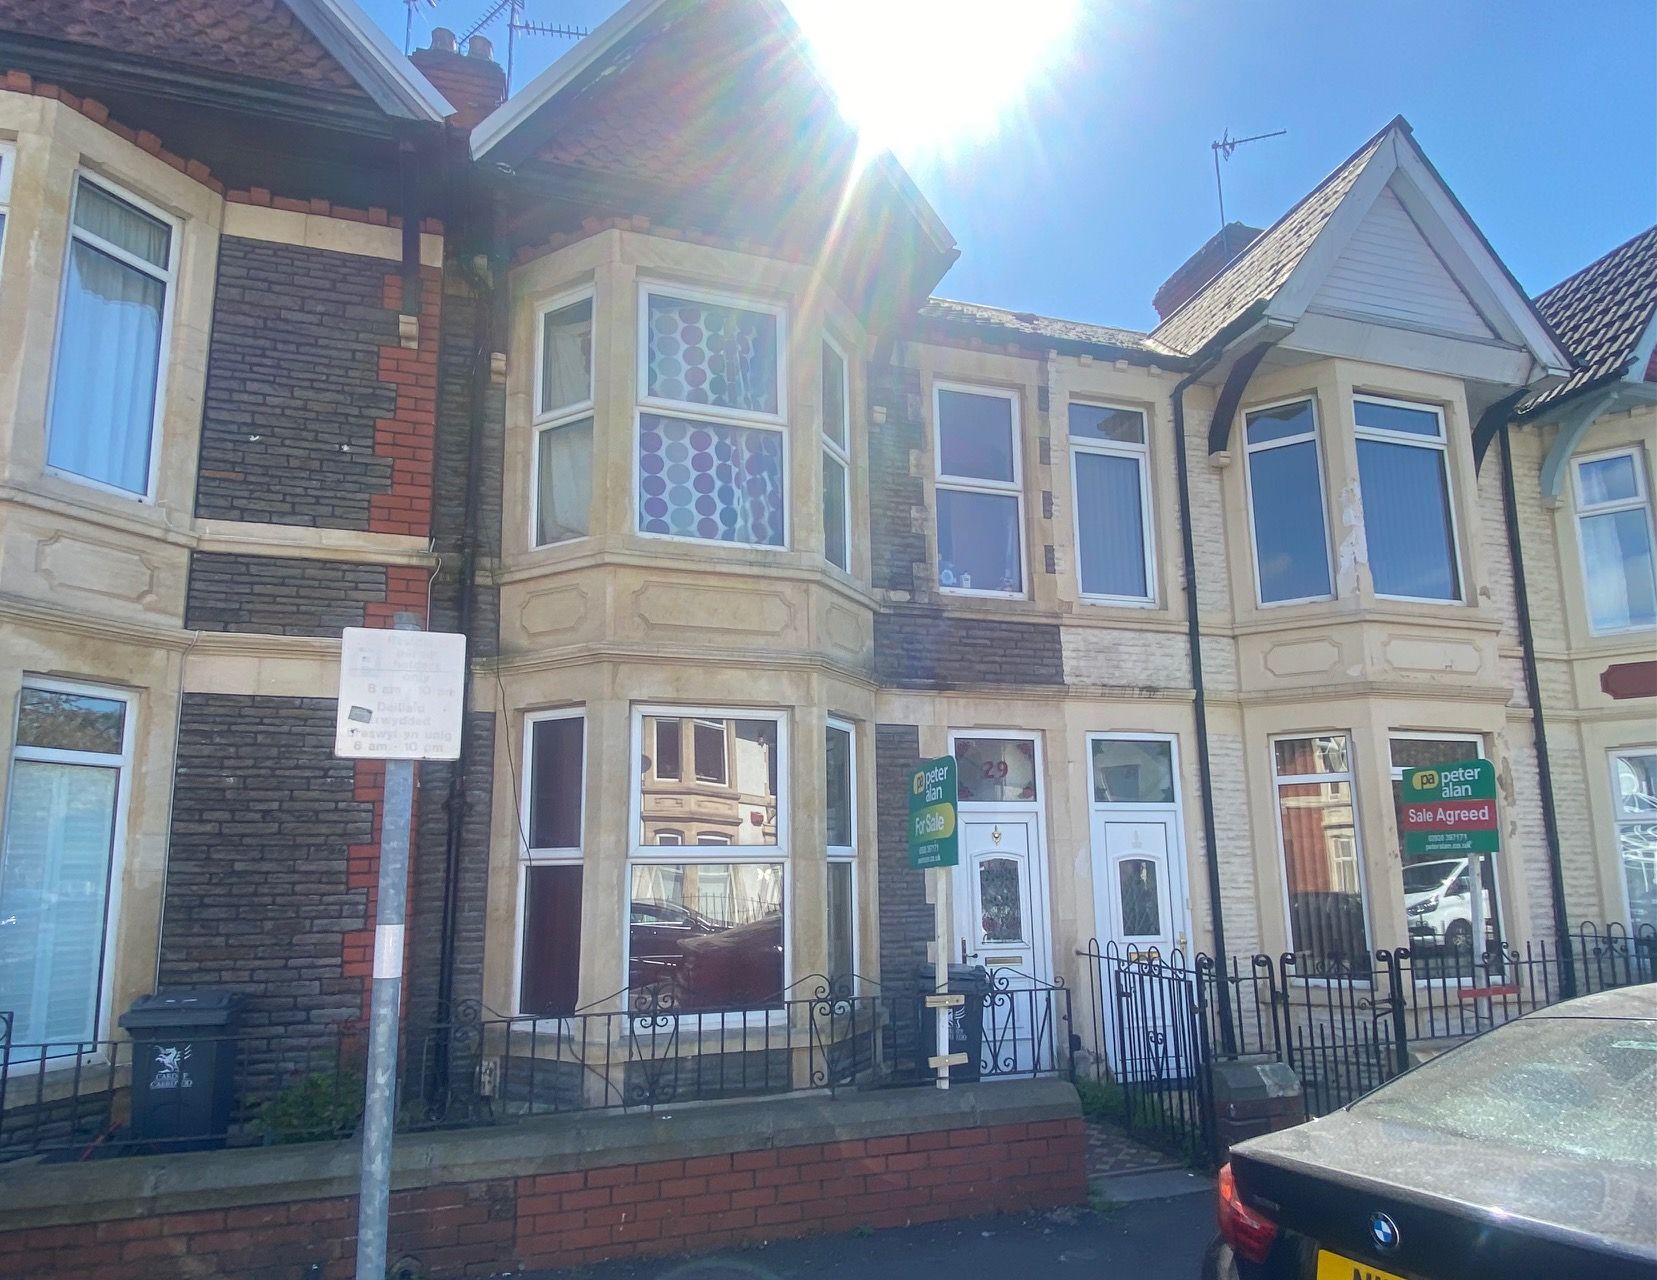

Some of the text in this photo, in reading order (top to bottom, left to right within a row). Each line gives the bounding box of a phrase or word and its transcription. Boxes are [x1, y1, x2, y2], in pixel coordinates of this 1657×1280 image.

[368, 743, 388, 751] am
[925, 765, 949, 789] peter
[982, 760, 1008, 779] 29
[1441, 767, 1481, 787] peter
[1420, 773, 1435, 790] pa
[1441, 782, 1472, 798] alan
[925, 783, 943, 802] alan
[1408, 805, 1489, 825] Sale Agreed
[915, 812, 945, 838] For Sale
